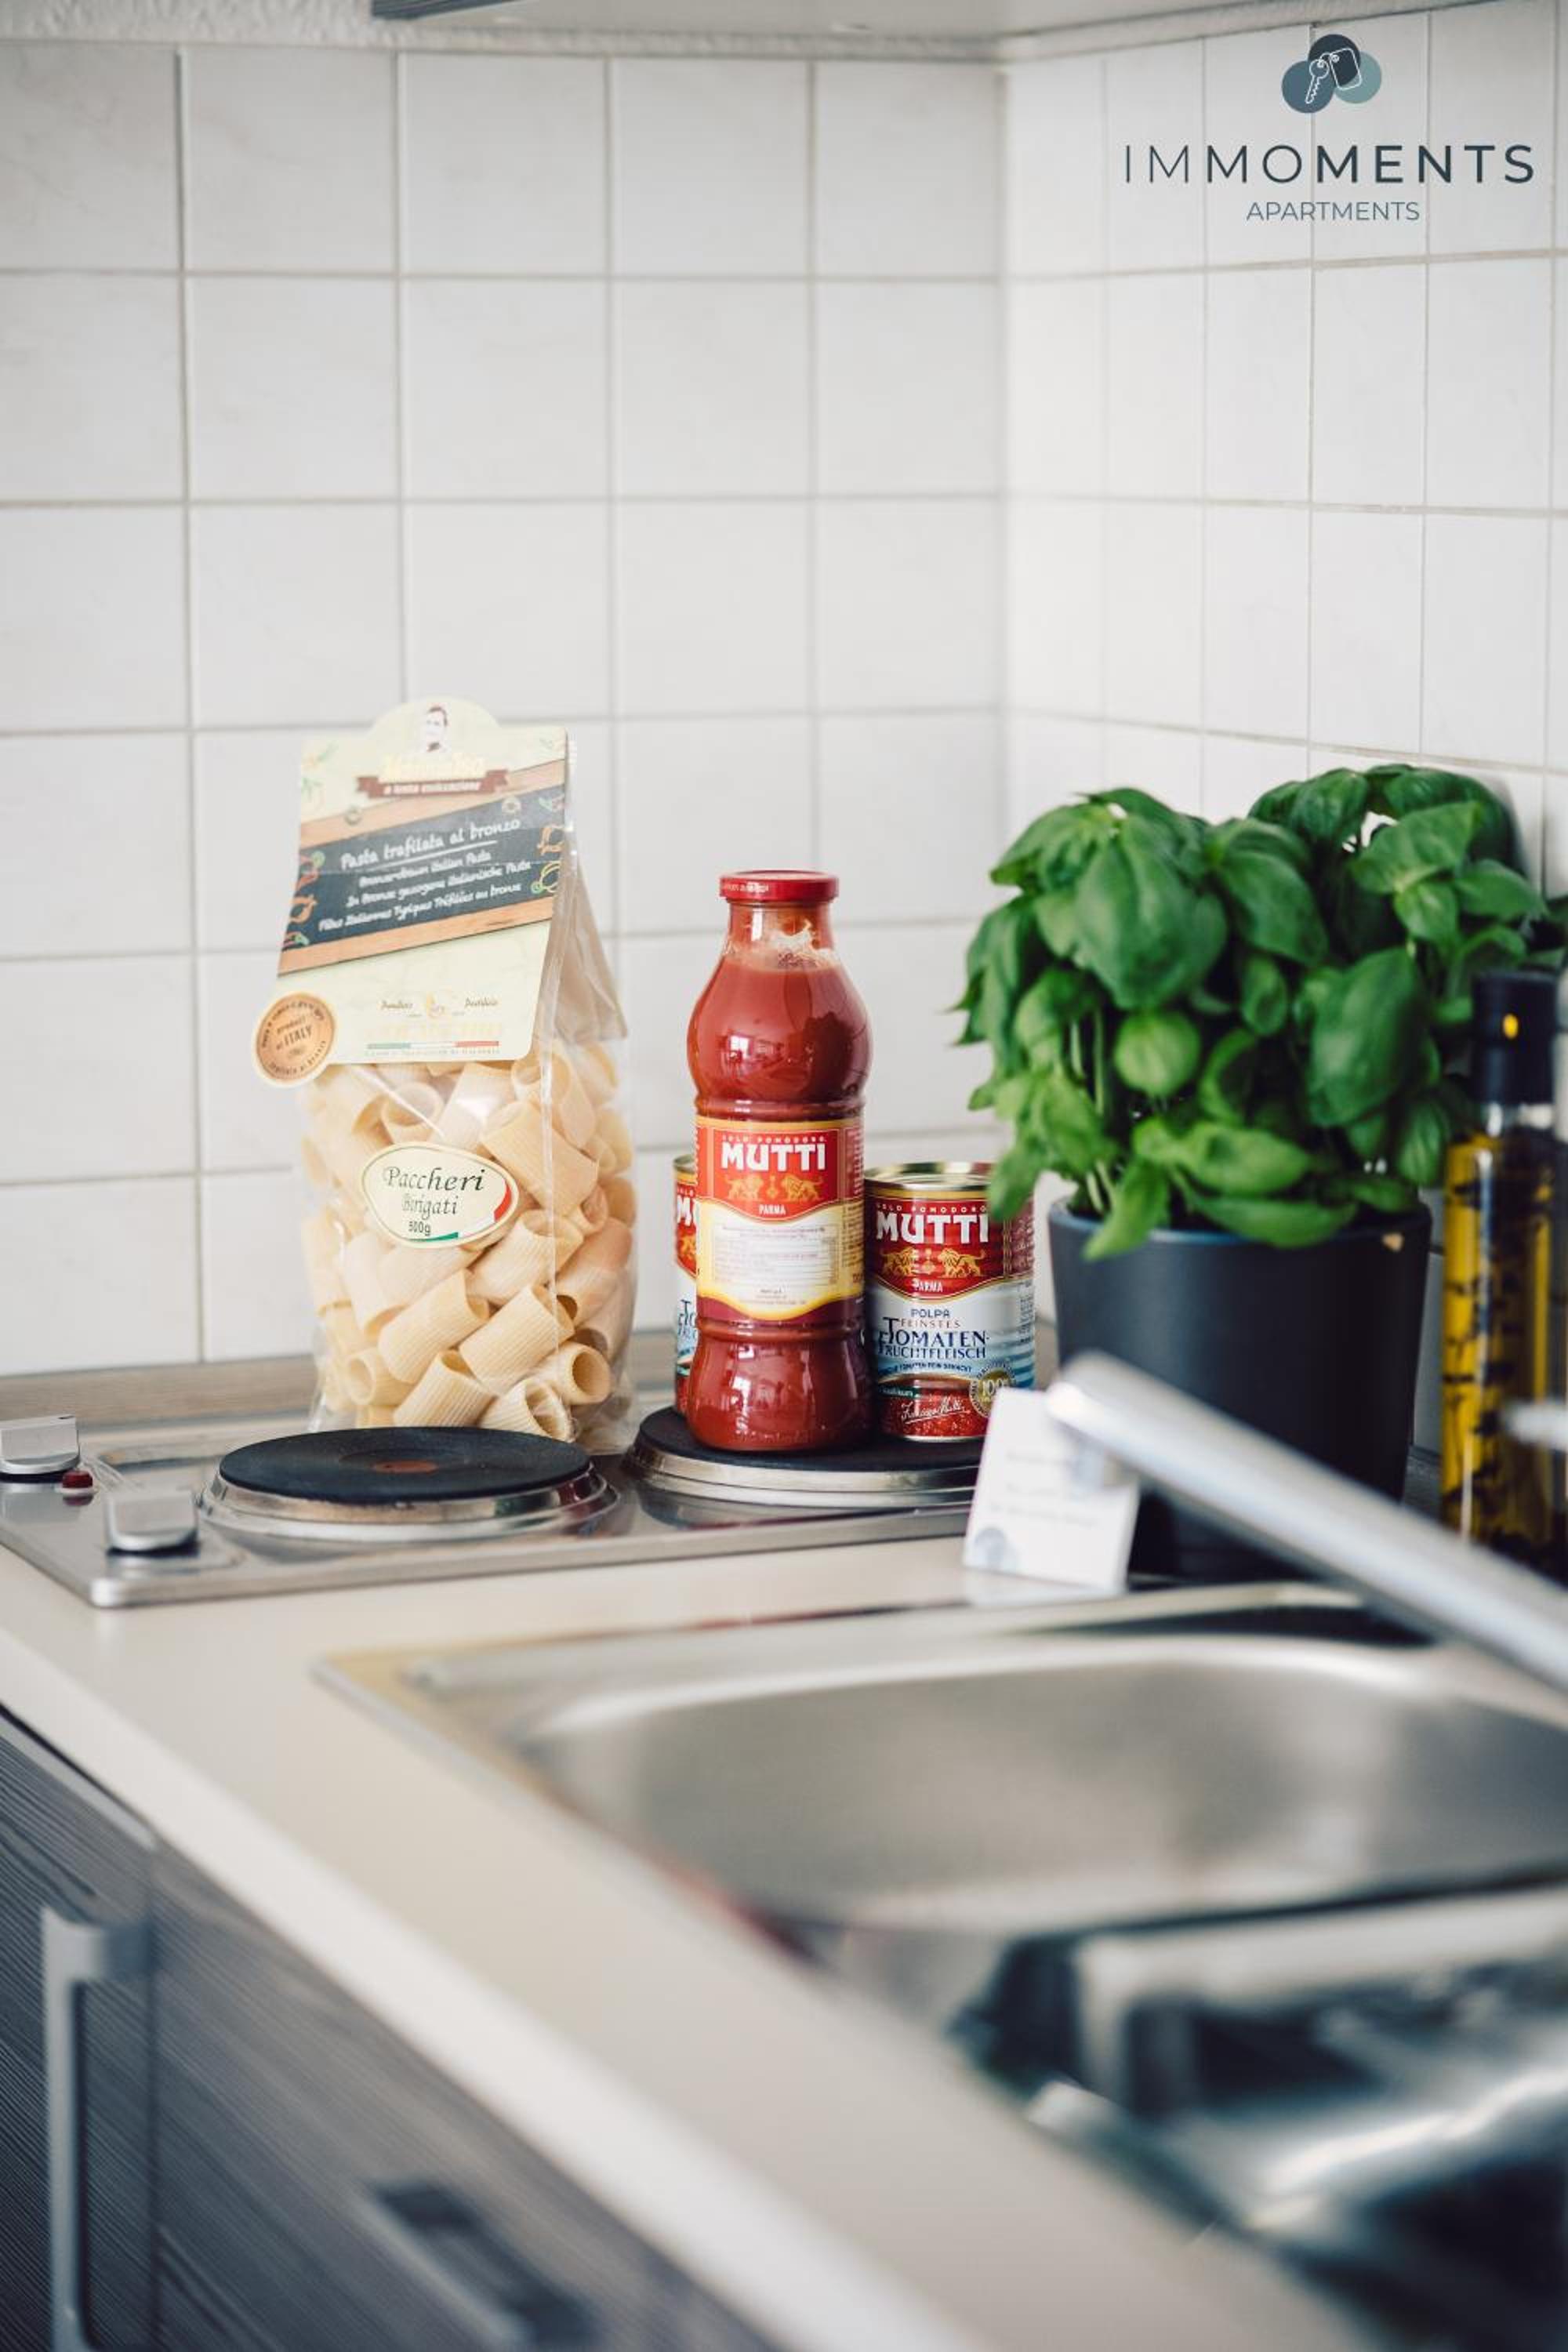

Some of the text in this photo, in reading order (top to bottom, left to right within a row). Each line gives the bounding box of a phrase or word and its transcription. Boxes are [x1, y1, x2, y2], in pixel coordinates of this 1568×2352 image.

[340, 847, 379, 872] Pasta
[450, 828, 464, 844] al
[470, 819, 521, 840] bronzo
[285, 1025, 312, 1046] ITALY
[720, 1142, 826, 1172] MUTTI
[382, 1165, 485, 1192] Paccheri
[758, 1204, 786, 1215] PARMA
[875, 1211, 989, 1244] MUTTI
[901, 1317, 961, 1329] FEINSTES
[910, 1308, 950, 1319] POLPA
